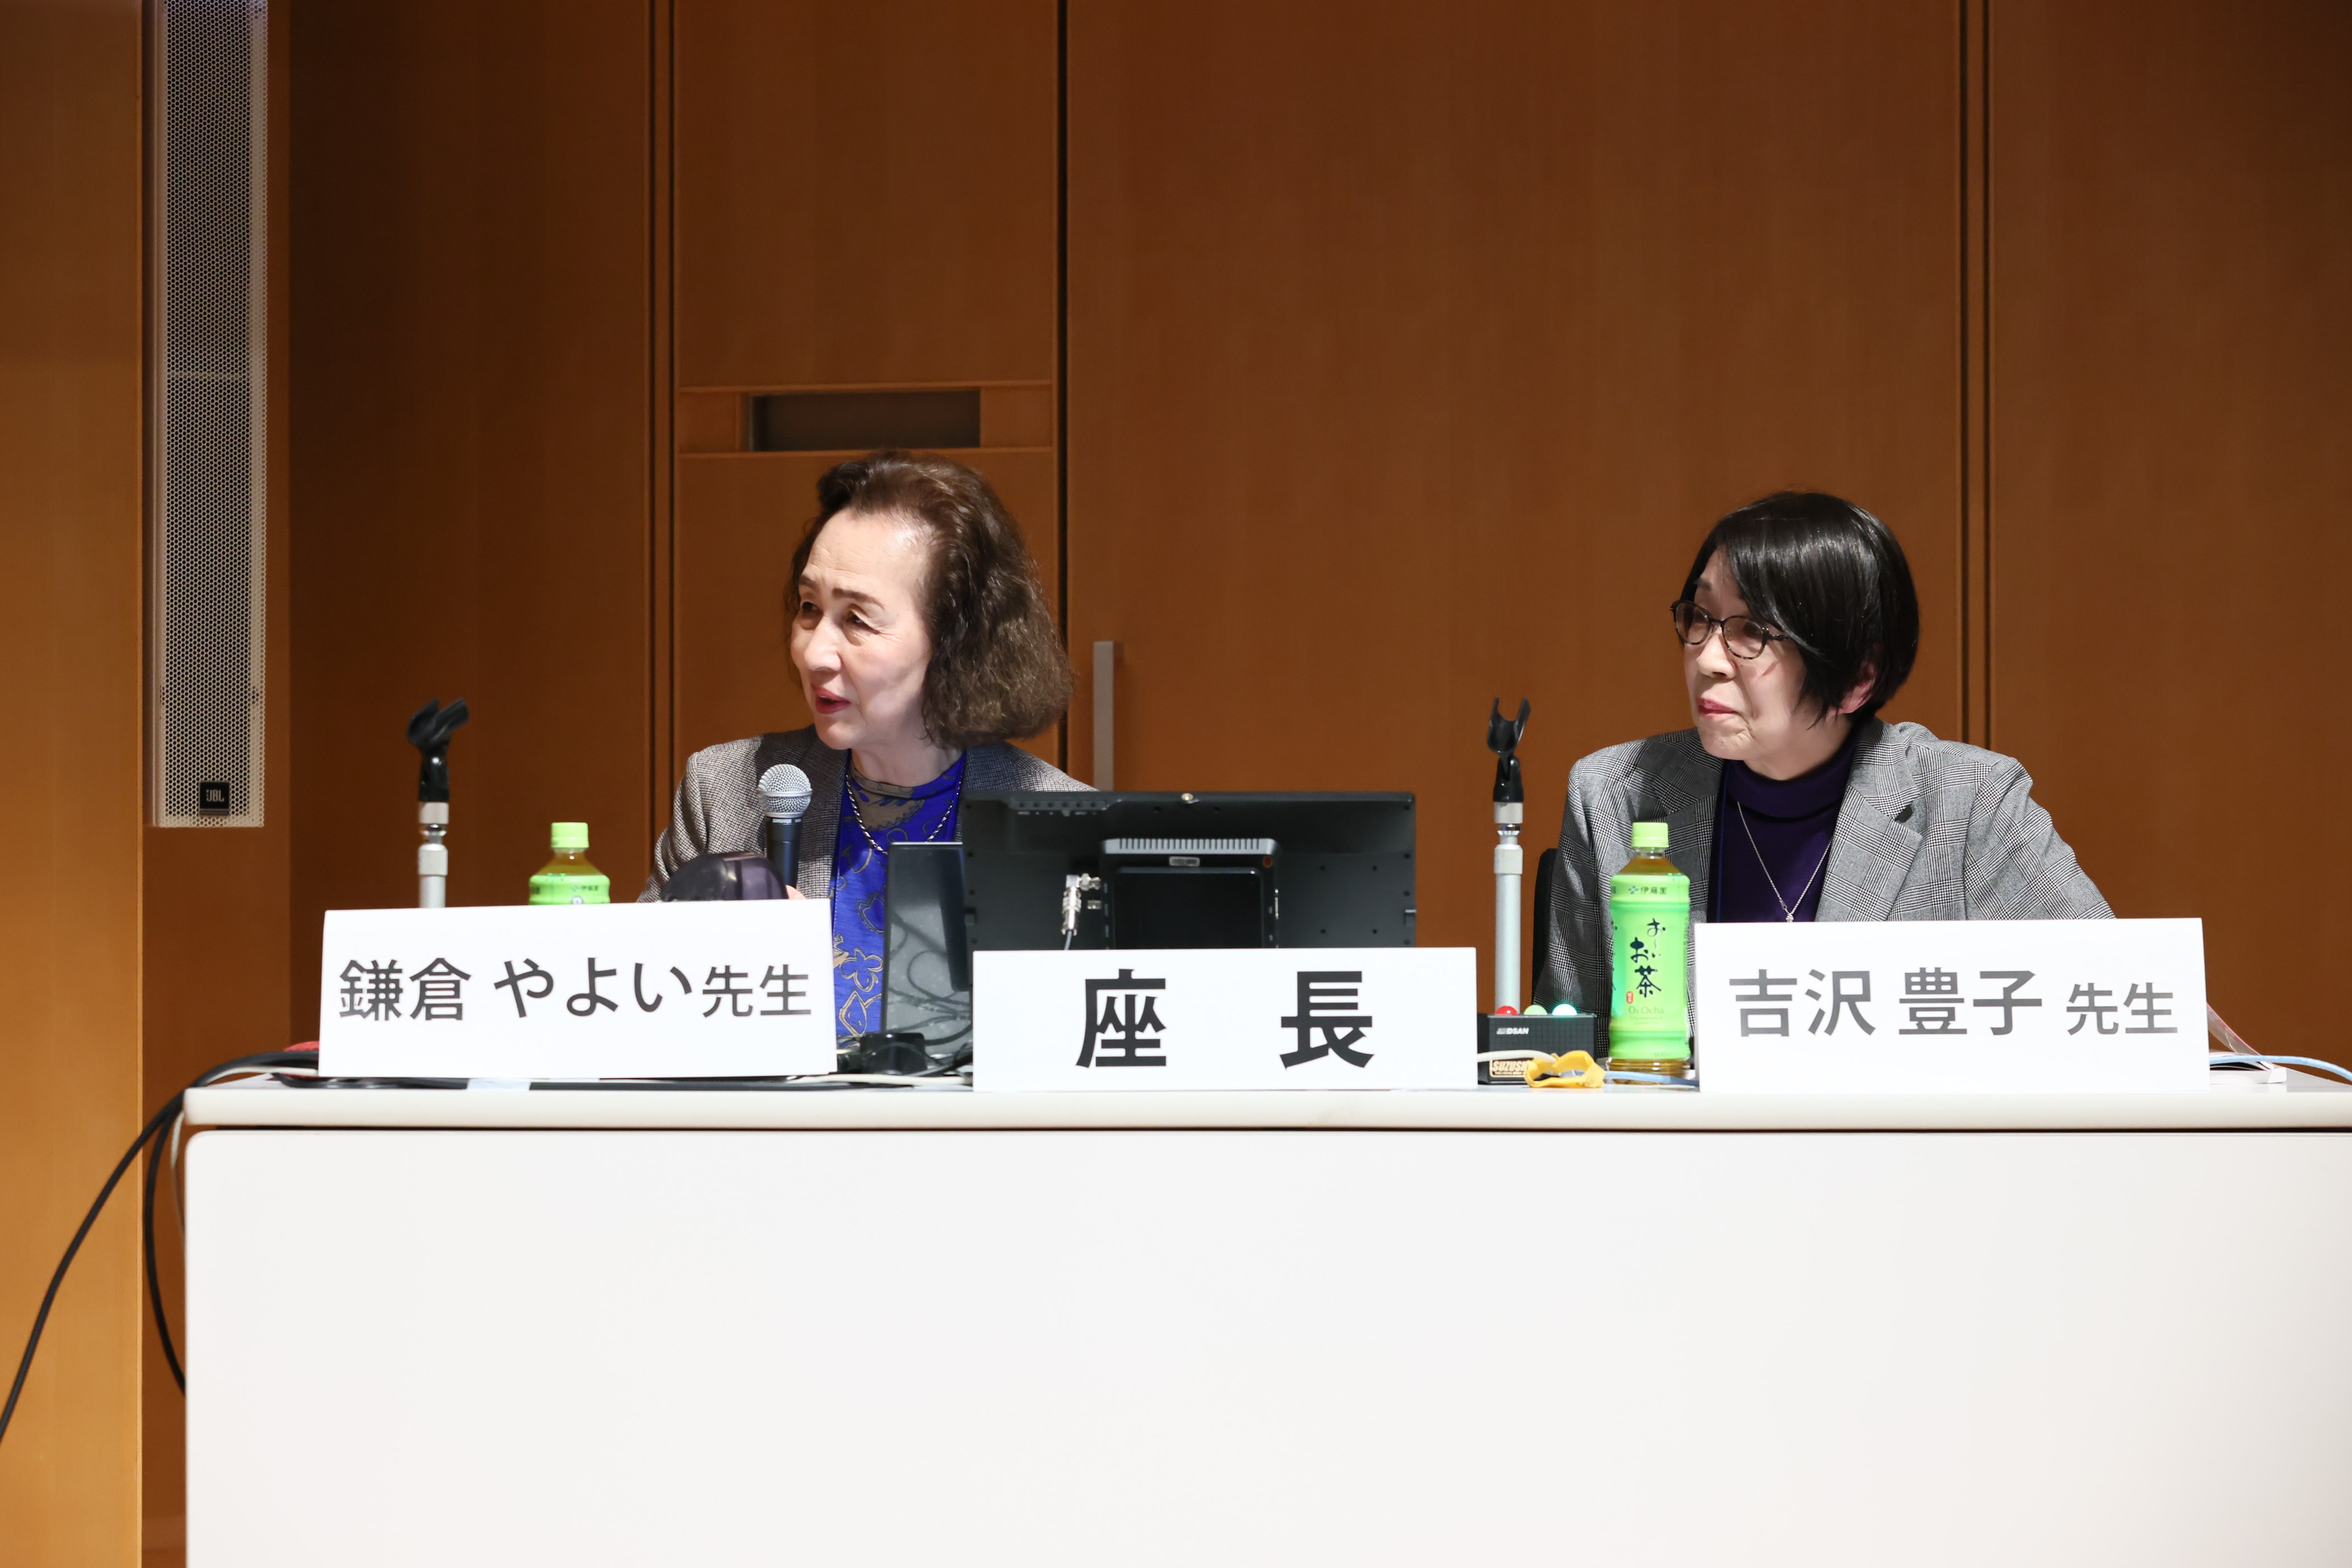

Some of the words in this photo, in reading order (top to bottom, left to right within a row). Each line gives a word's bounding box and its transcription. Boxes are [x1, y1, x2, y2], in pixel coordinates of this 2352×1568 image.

[206, 789, 225, 802] JBL
[1630, 936, 1662, 998] お茶
[339, 957, 472, 1021] 鎌倉
[1729, 969, 1876, 1037] 吉沢
[1898, 967, 2043, 1036] 豊子
[2066, 982, 2178, 1035] 先生
[1641, 1006, 1664, 1014] Ocha
[1492, 1060, 1529, 1072] SUZUSH
